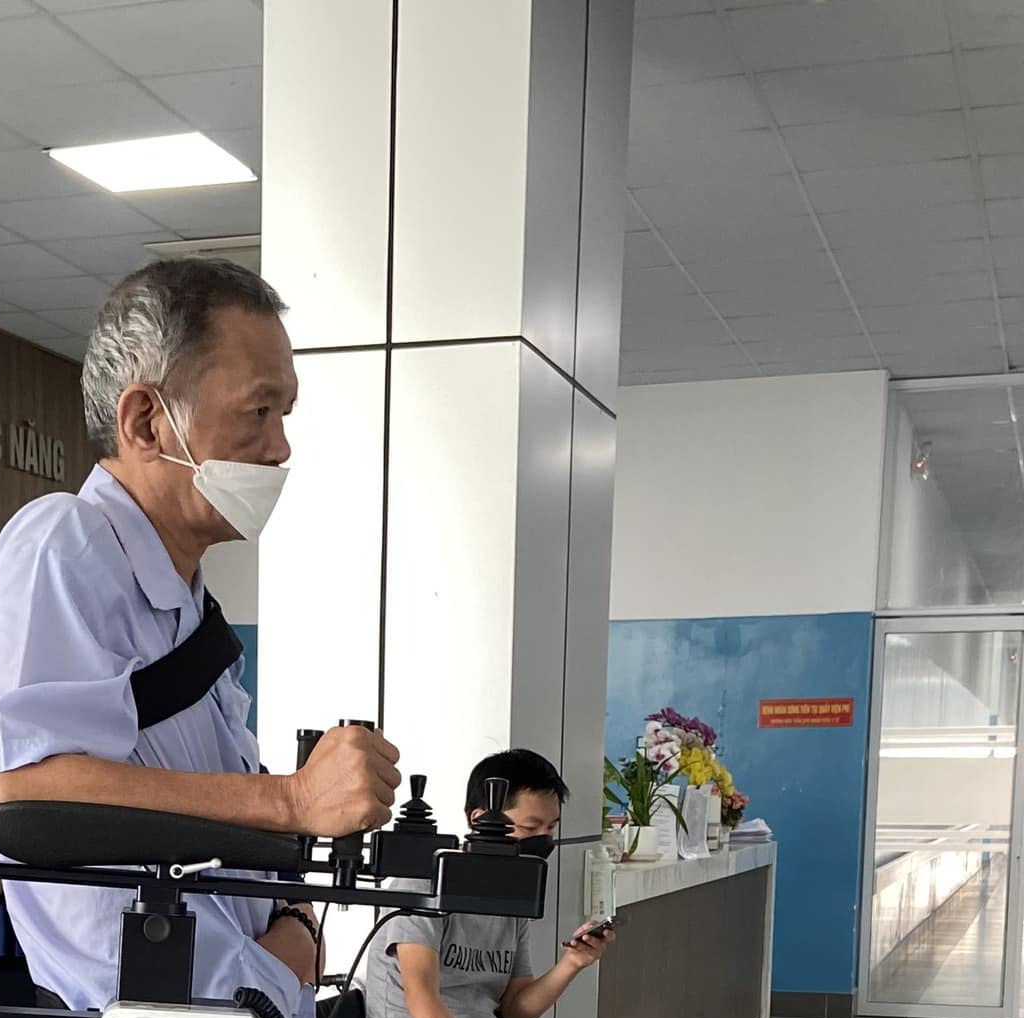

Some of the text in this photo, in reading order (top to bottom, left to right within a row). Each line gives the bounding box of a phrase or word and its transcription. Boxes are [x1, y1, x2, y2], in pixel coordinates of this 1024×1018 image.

[9, 417, 65, 482] NĂNG
[443, 943, 513, 974] CALVIN KLEI
